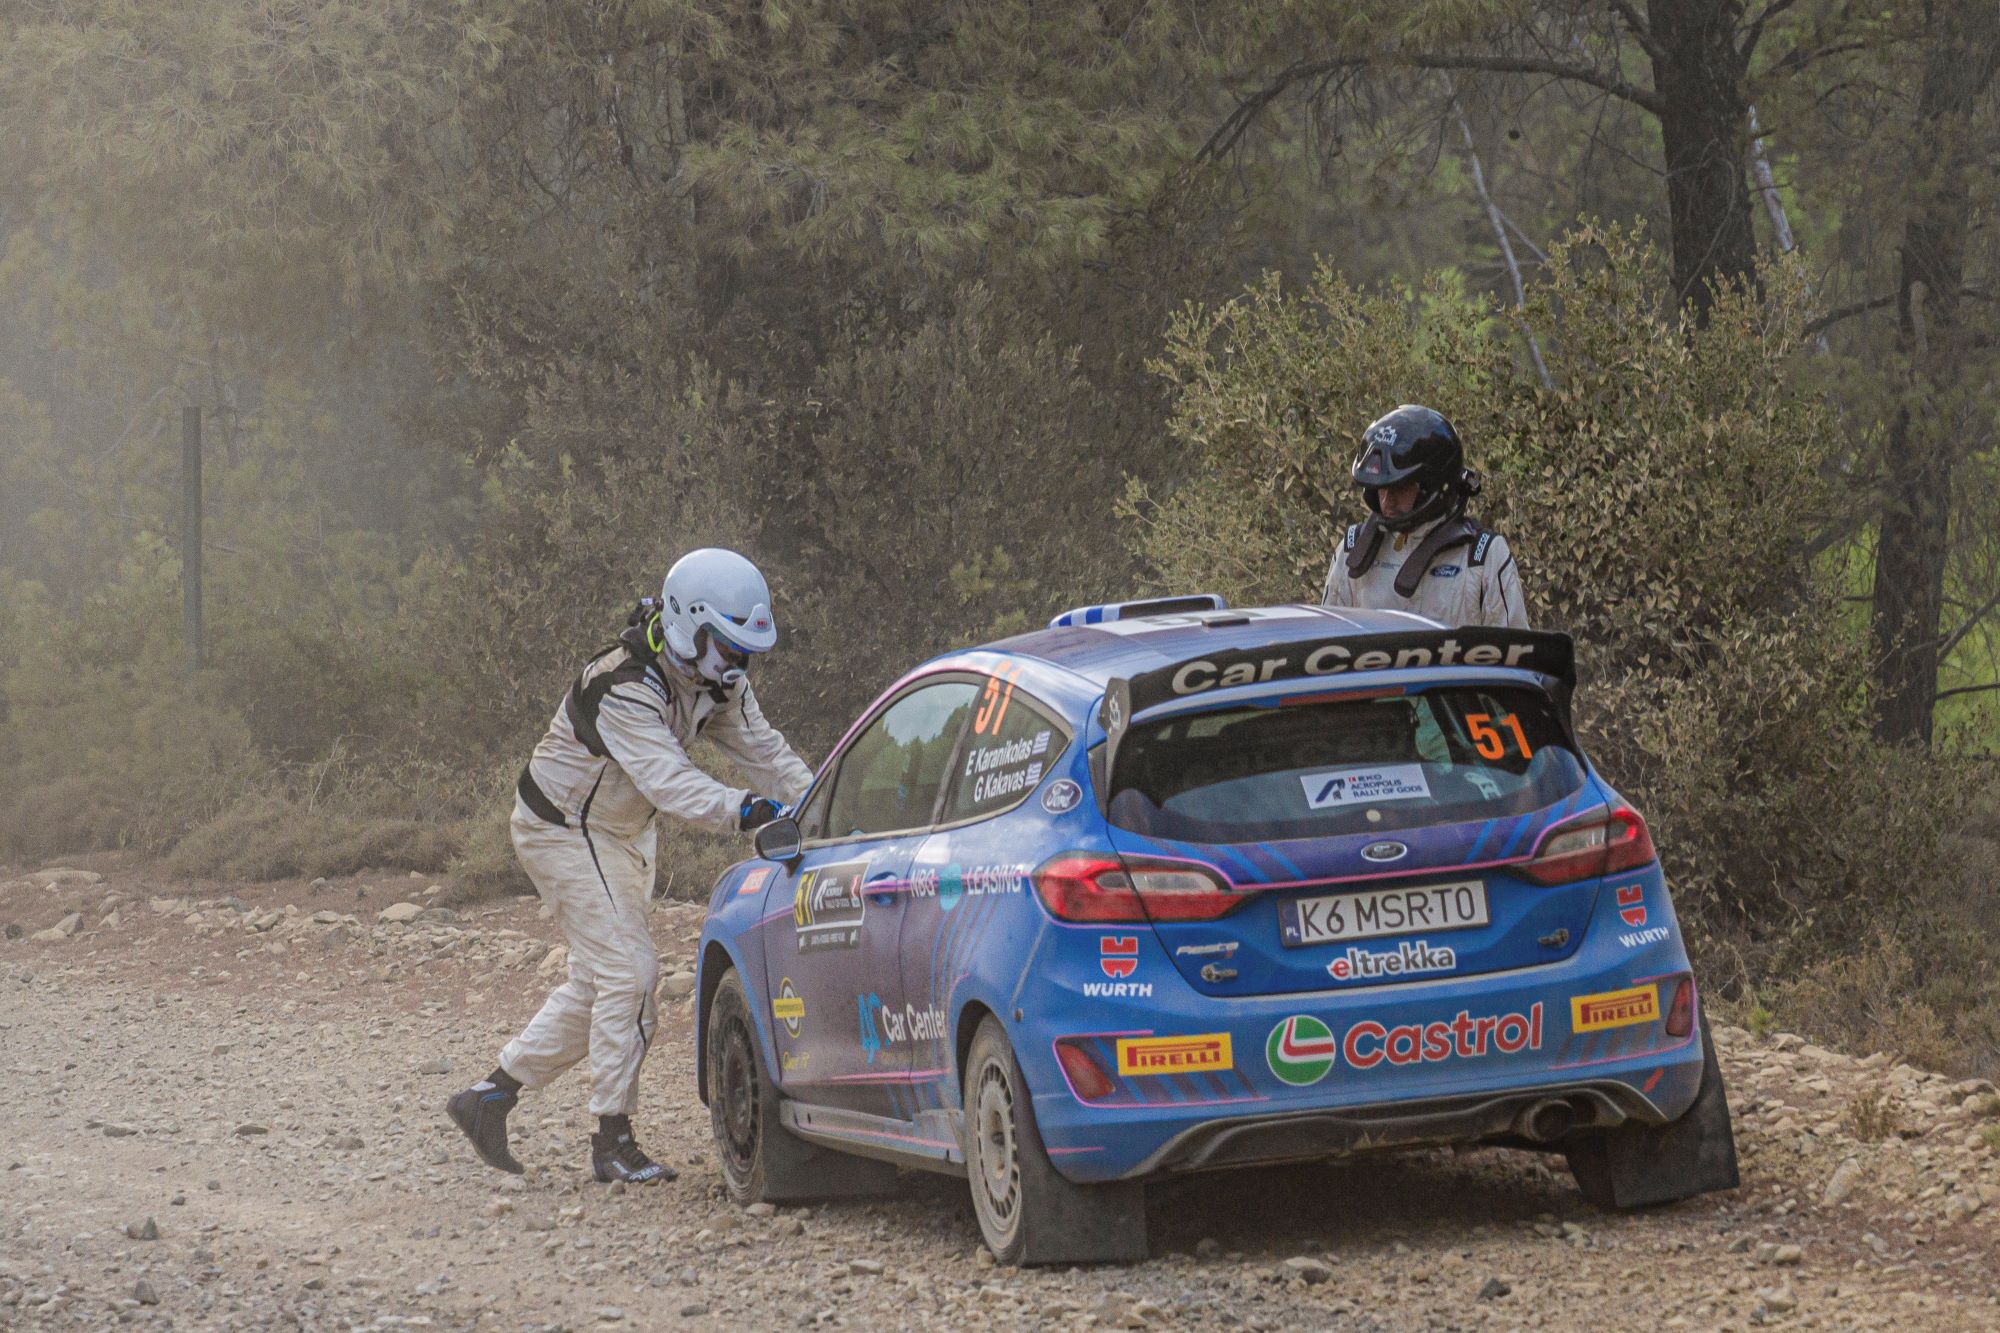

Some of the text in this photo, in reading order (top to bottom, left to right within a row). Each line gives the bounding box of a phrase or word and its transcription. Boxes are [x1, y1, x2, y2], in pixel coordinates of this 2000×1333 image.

[1172, 638, 1534, 695] Car Center
[974, 661, 1024, 736] 51
[1465, 713, 1533, 759] 51
[965, 738, 1033, 776] E Karanikolas
[974, 769, 1026, 802] G Kakavas
[1046, 783, 1074, 808] Ford
[1351, 780, 1402, 790] ACROPOLIS
[1353, 785, 1423, 799] RALLY OF GODS
[911, 863, 1026, 898] NBG LEASING
[1286, 927, 1299, 937] PL
[1302, 900, 1344, 938] K6
[1619, 927, 1669, 948] WURTH
[1328, 940, 1456, 981] eltrekka
[1083, 983, 1153, 997] WURTH
[881, 1002, 947, 1042] Car Center
[1580, 992, 1653, 1024] PIRELLI
[1343, 1001, 1543, 1069] Castrol
[1126, 1041, 1221, 1068] PIRELLI
